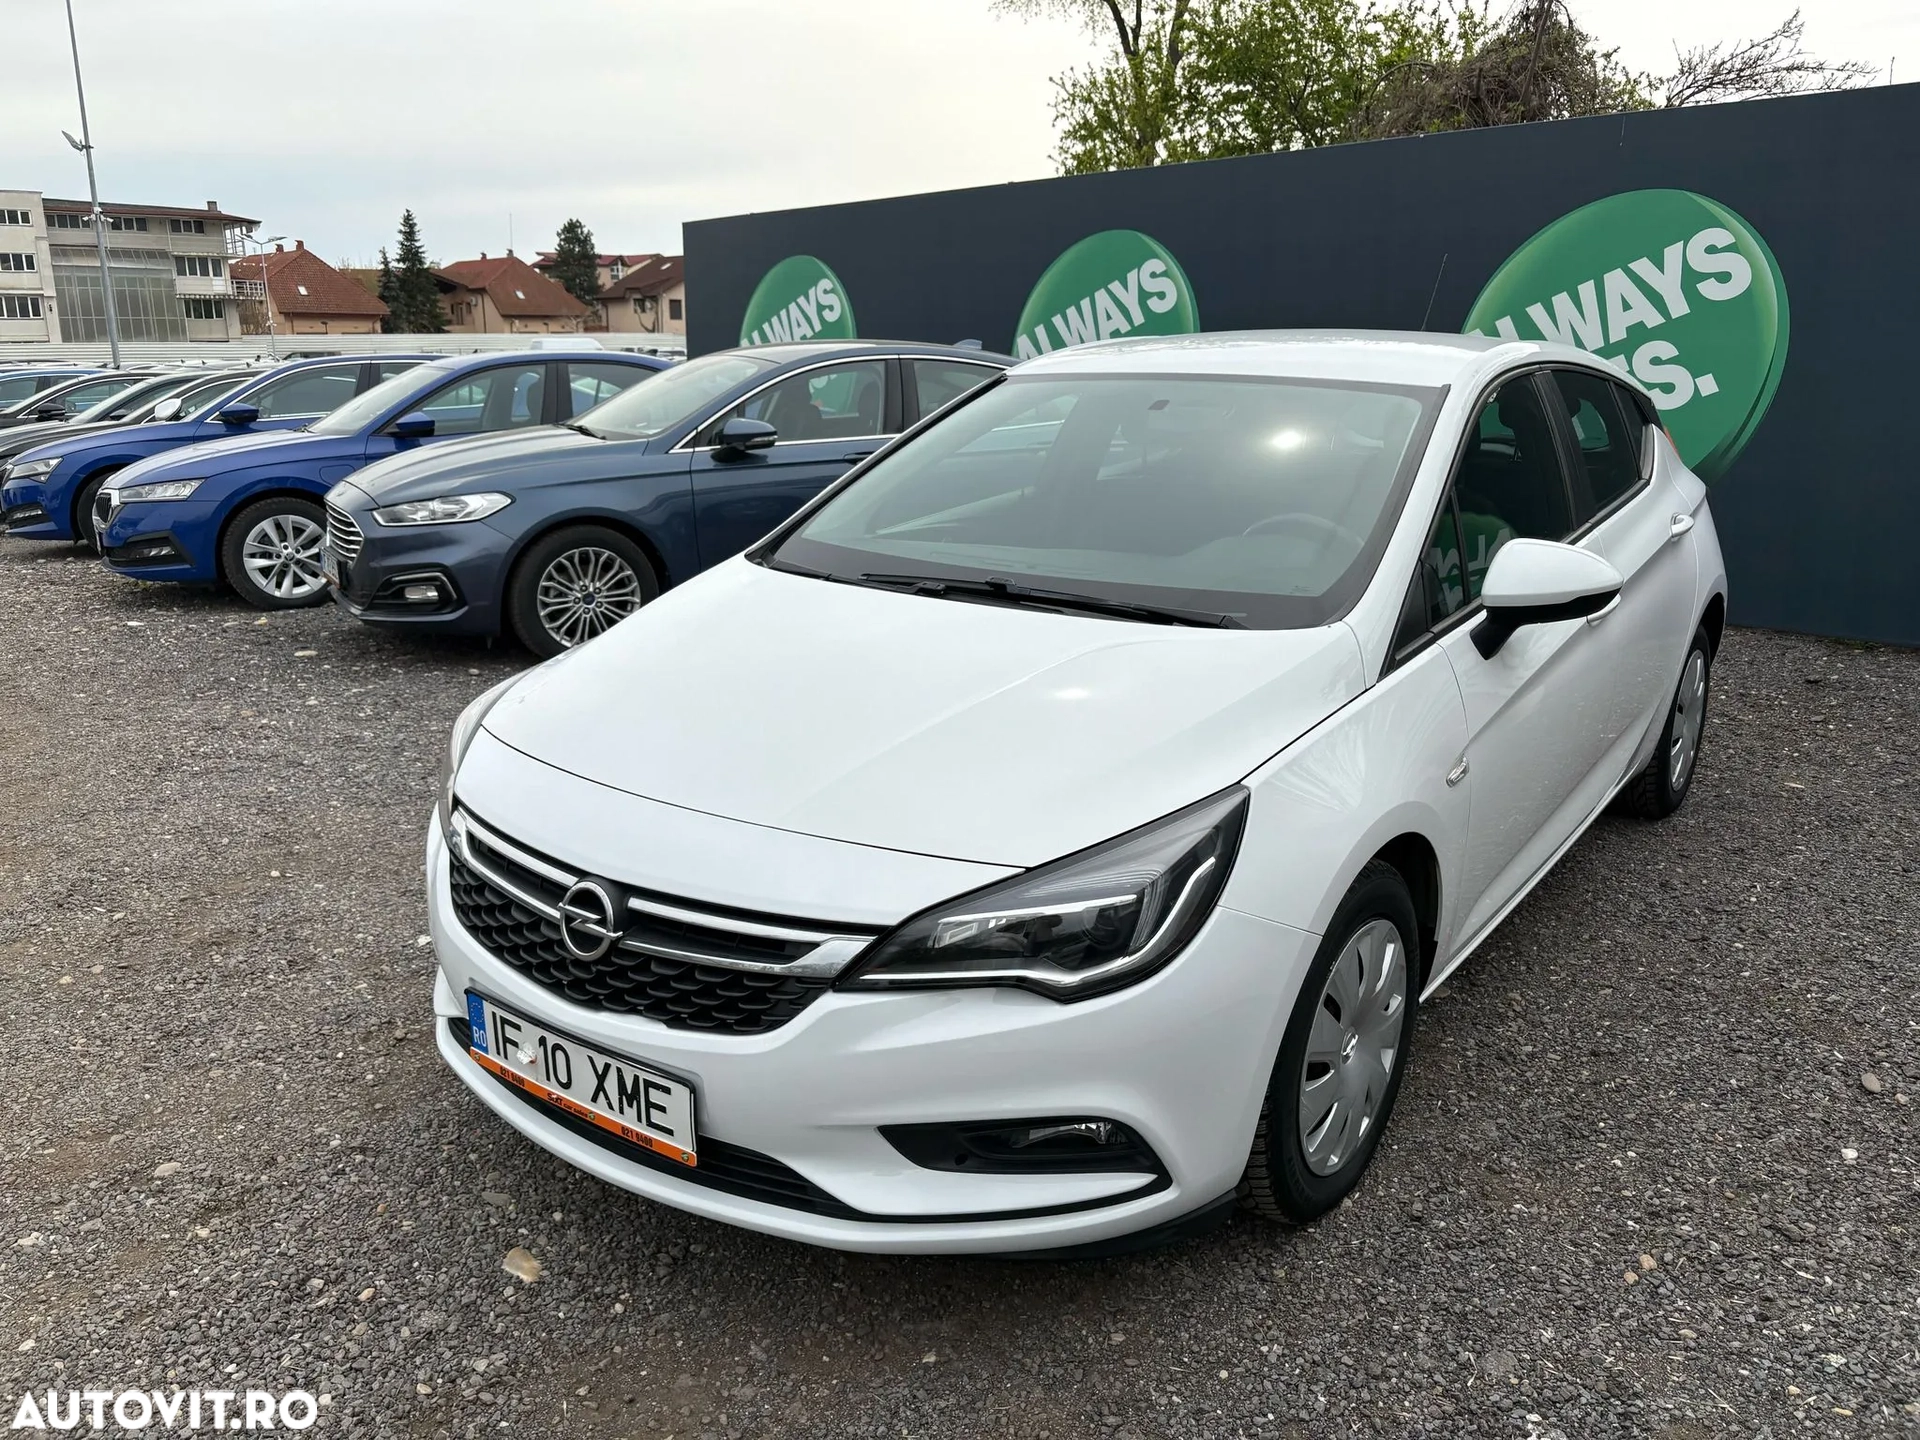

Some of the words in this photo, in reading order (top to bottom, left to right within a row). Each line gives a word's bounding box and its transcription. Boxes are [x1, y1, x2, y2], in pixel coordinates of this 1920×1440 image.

[1466, 227, 1752, 352] WAYS
[472, 1026, 487, 1047] RO
[491, 1010, 523, 1060] IF
[538, 1035, 573, 1090] 10
[586, 1054, 675, 1137] XME
[563, 1103, 573, 1112] car
[573, 1107, 588, 1118] sales
[621, 1126, 634, 1139] 021
